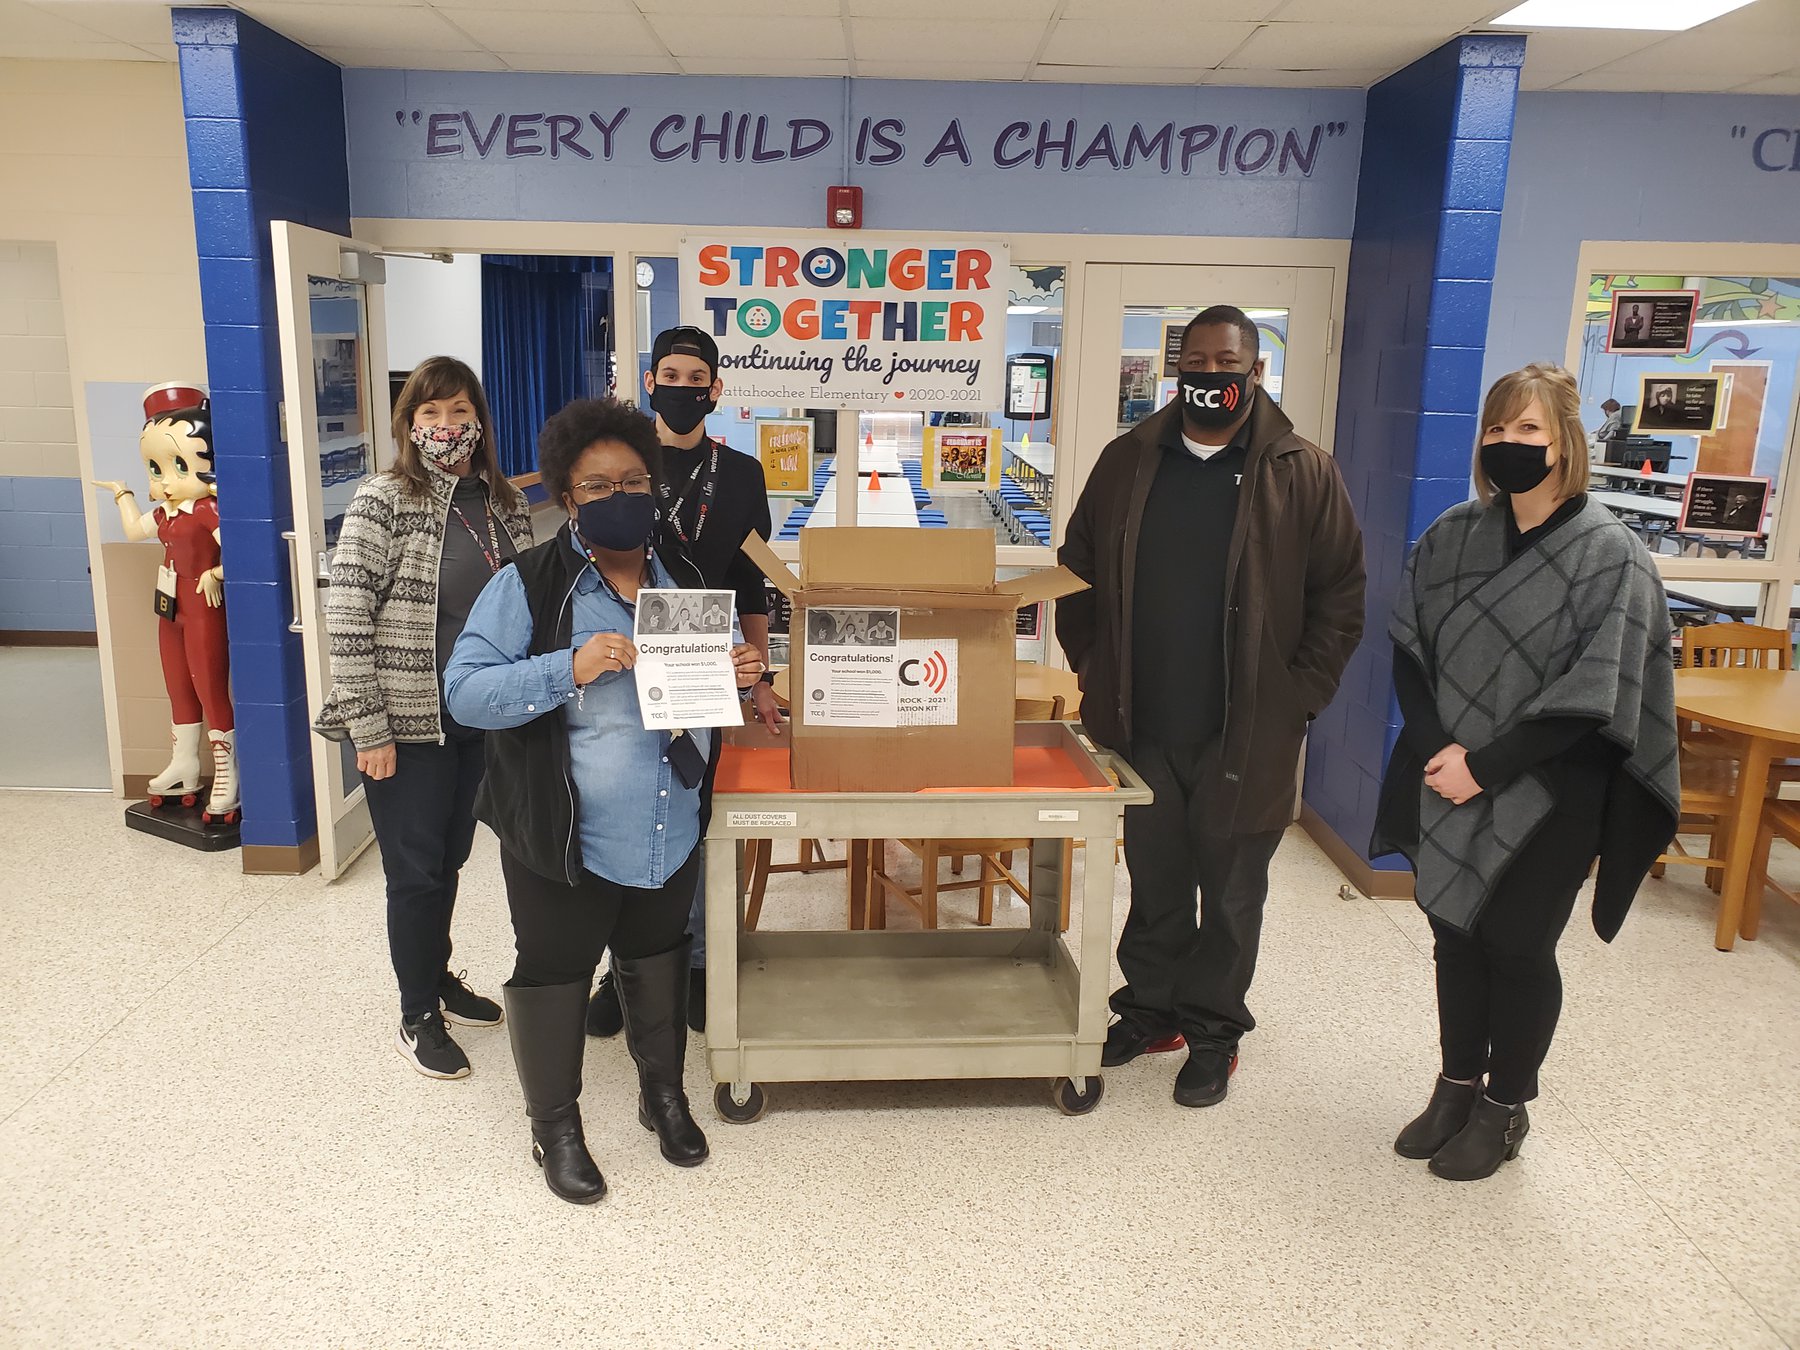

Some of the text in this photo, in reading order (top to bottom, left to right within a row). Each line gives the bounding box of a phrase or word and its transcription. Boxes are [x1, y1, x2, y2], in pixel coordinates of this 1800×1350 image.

[649, 110, 832, 162] CHILD
[855, 116, 906, 166] IS
[922, 117, 972, 167] A
[698, 244, 992, 291] STRONGER
[704, 297, 985, 341] TOGETHER
[718, 344, 981, 386] ontinuing the journey
[719, 385, 982, 404] attahoochee Elementary 2020-2021
[1183, 384, 1221, 409] TCC
[667, 496, 684, 523] SAMSUNG
[160, 595, 168, 612] B
[640, 643, 728, 656] Congratulations!
[810, 653, 894, 664] Congratulations!
